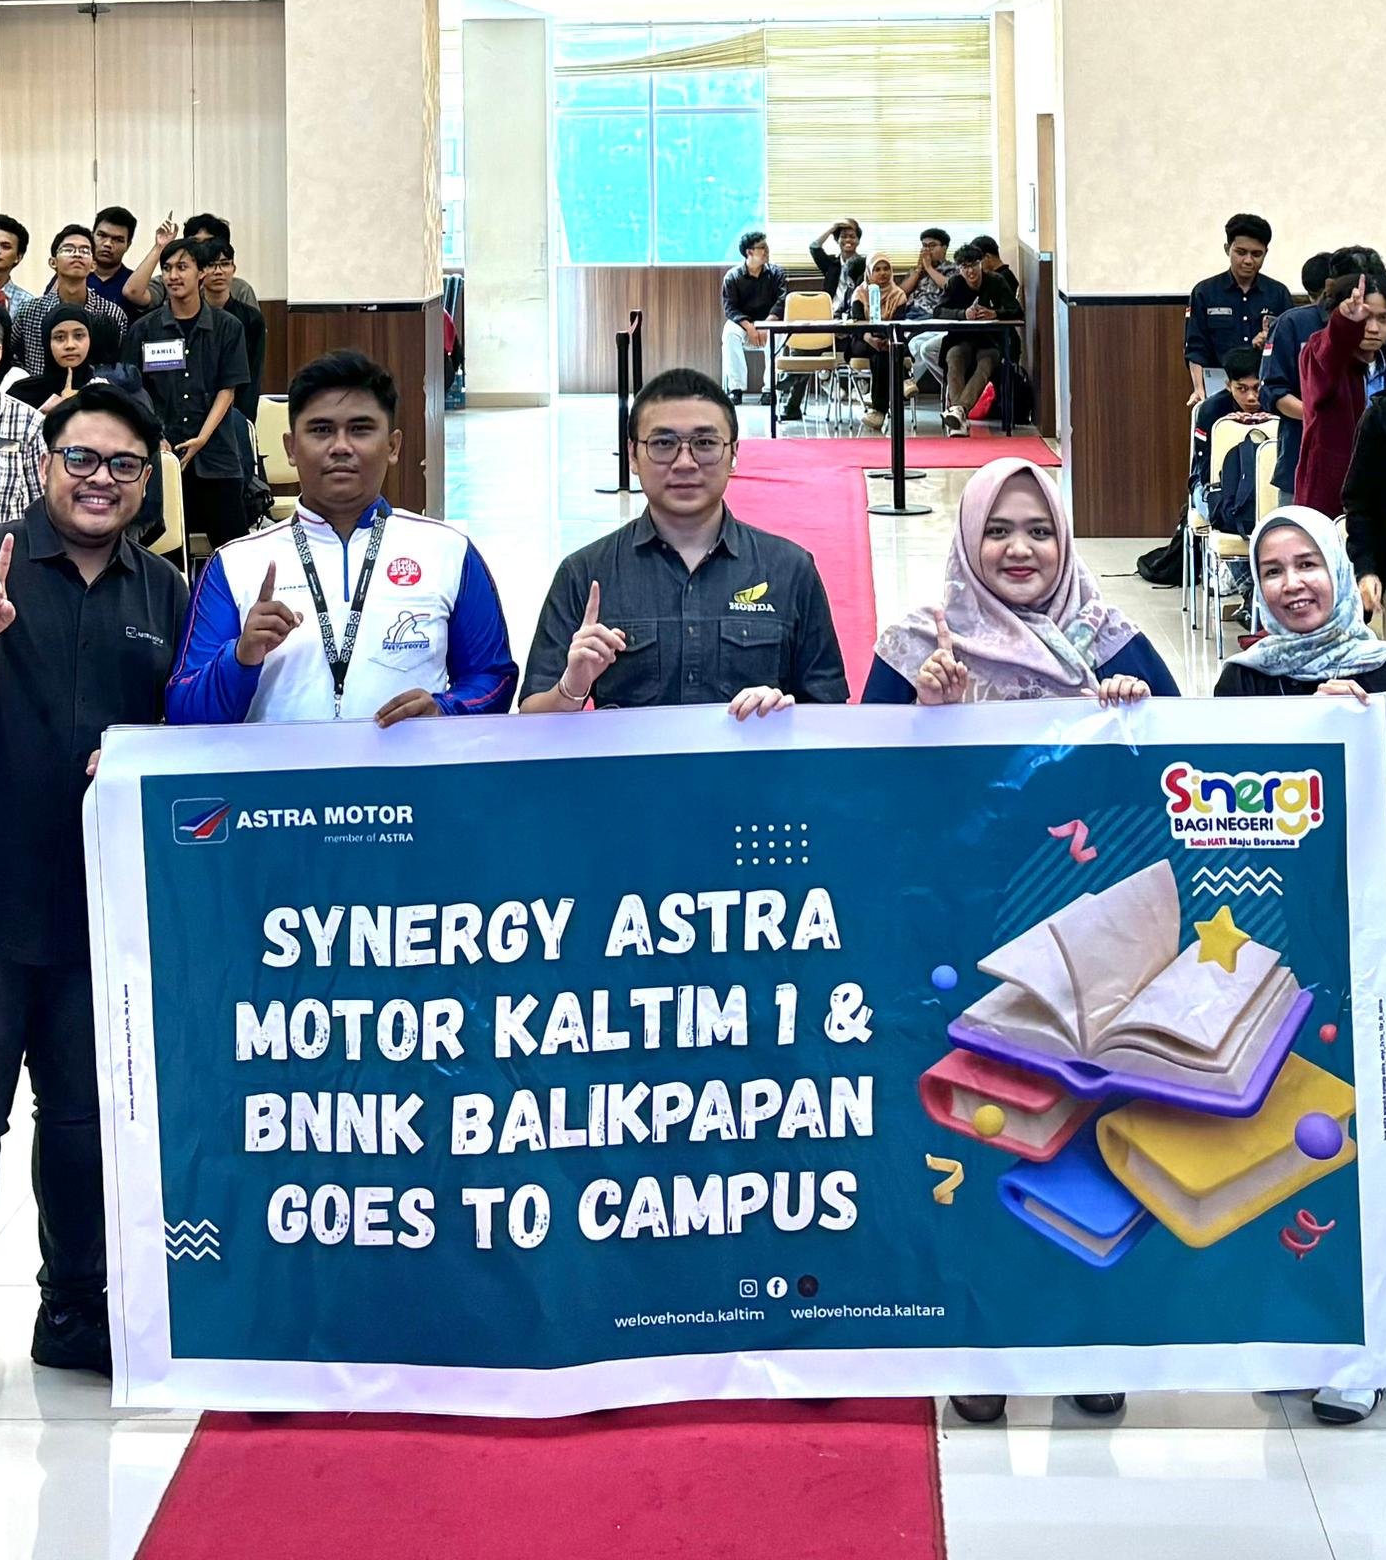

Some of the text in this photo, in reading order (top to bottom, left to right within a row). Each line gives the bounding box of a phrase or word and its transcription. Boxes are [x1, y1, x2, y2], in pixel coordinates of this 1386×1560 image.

[728, 601, 776, 612] HONDA
[236, 805, 413, 829] ASTRA MOTOR
[1174, 817, 1274, 832] BAGI NEGERI
[324, 832, 363, 843] member
[379, 833, 414, 843] ASTRA
[1229, 837, 1251, 847] Maju
[261, 887, 842, 968] SYNERGY ASTRA
[235, 998, 465, 1062] MOTOR
[494, 984, 748, 1059] KALTIM
[824, 982, 874, 1043] &
[244, 1075, 874, 1155] BNNK BALIKPAPAN
[267, 1170, 858, 1249] GOES TO CAMPUS
[614, 1303, 945, 1328] welovehonda.kaltim welovehonda.kaltara
